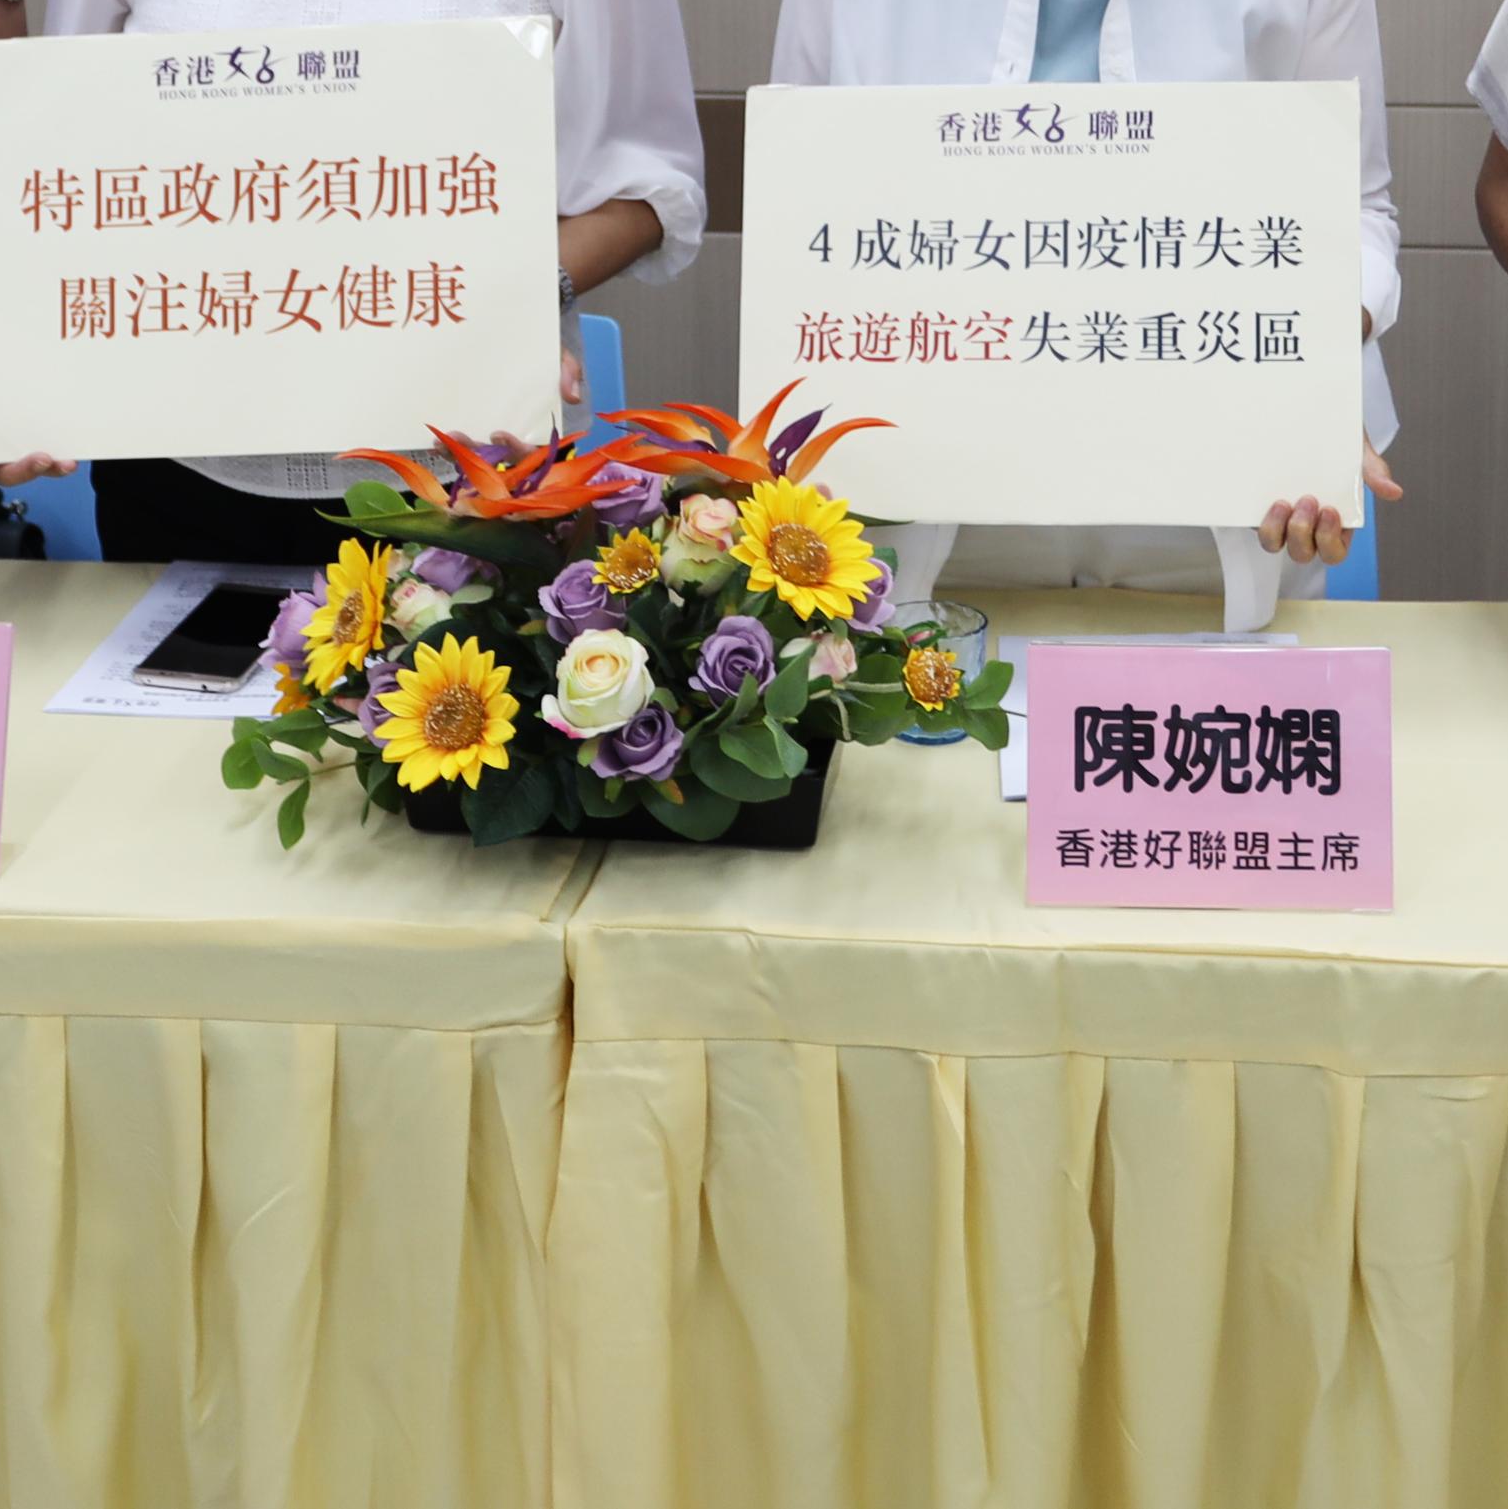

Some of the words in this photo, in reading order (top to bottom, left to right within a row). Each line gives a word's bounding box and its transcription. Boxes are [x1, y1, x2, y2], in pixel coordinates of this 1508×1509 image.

[158, 88, 197, 101] HONG
[201, 86, 239, 99] KONG
[313, 82, 358, 95] UNION
[943, 145, 983, 157] HONG
[987, 145, 1027, 157] KONG
[1031, 144, 1098, 156] WOMEN'S
[1104, 142, 1151, 155] UNION
[20, 151, 501, 234] 特區政府須加強
[60, 262, 467, 341] 關注婦女健康
[794, 310, 1306, 365] 旅遊航空失業重災區
[1074, 703, 1342, 796] 陳婉嫻
[1055, 828, 1361, 873] 香港好聯盟主席
